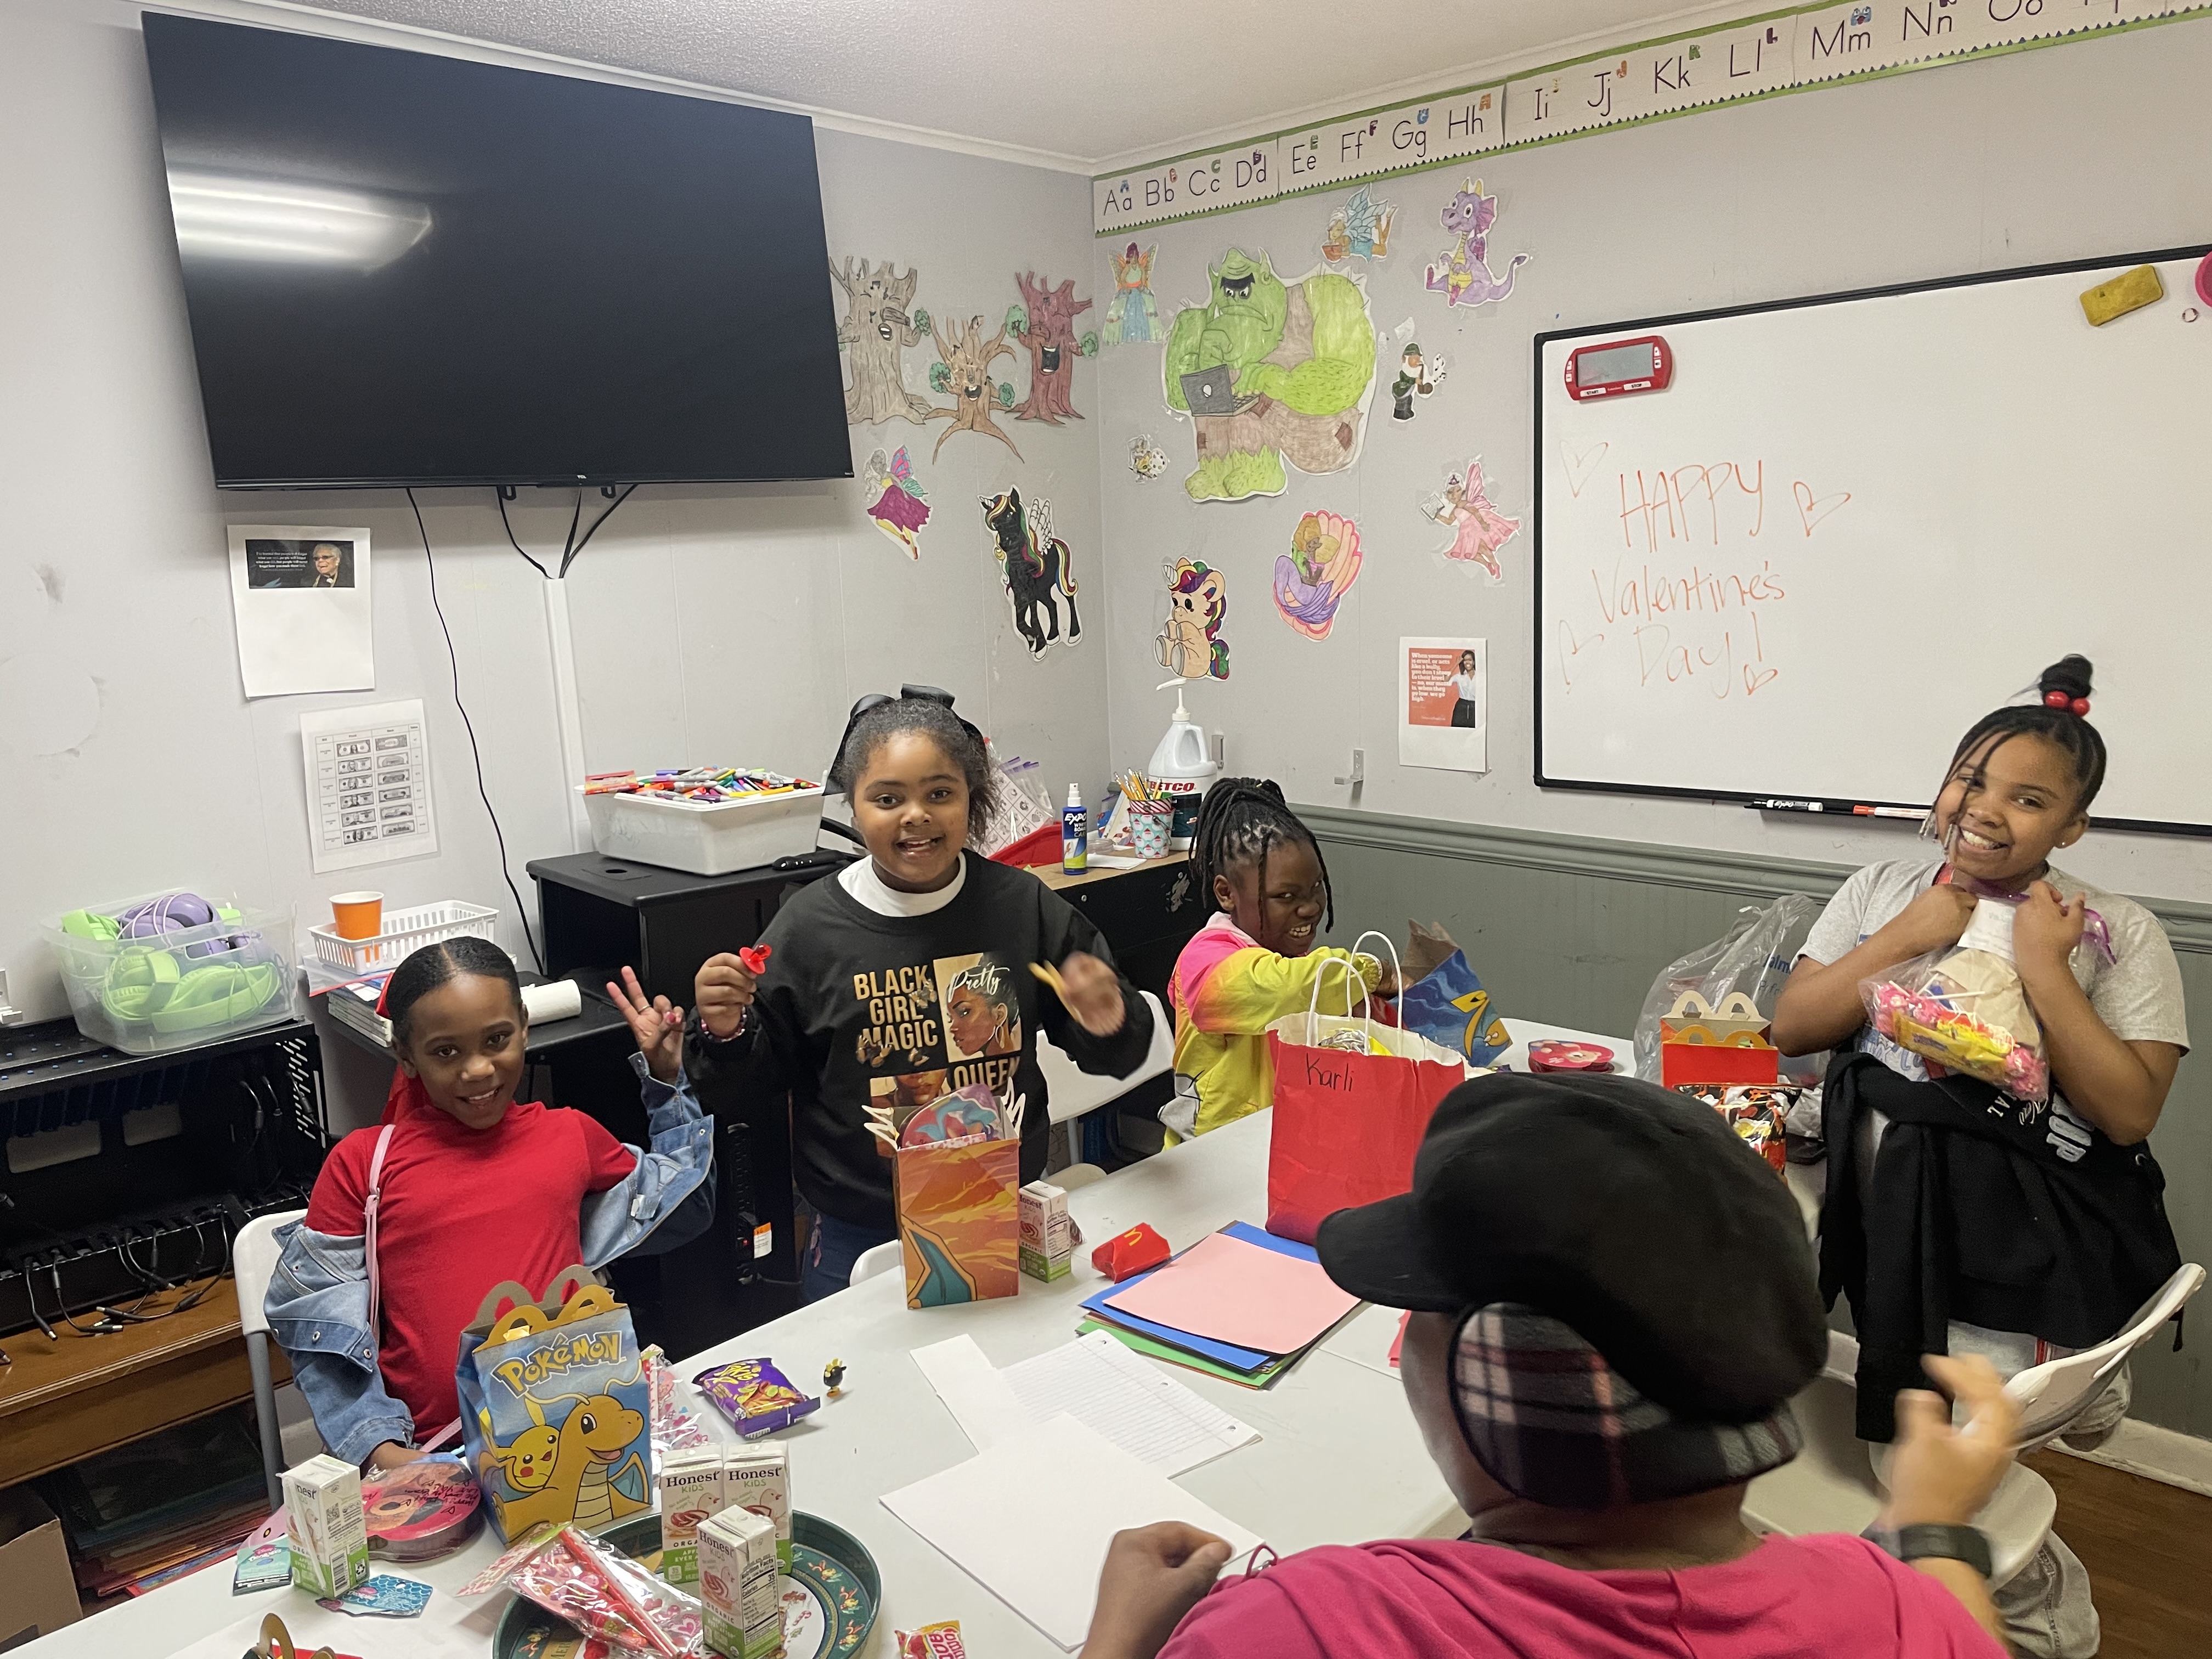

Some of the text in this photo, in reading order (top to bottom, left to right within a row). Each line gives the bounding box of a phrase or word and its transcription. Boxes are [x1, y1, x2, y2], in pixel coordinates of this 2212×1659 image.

[1103, 189, 1132, 216] Aa
[1146, 178, 1175, 207] Bb
[1188, 170, 1220, 196] Cc
[1237, 154, 1266, 188] Dd
[1292, 145, 1316, 174] Ee
[1341, 130, 1364, 163] Ff
[1392, 121, 1426, 157] Gg
[1448, 105, 1483, 139] Hh
[1534, 88, 1548, 120] Ii
[1588, 71, 1611, 117] Jj
[1655, 55, 1690, 94] Kk
[1730, 39, 1761, 77] Ll
[1812, 20, 1871, 60] Mm
[1903, 2, 1953, 41] Nn
[1620, 460, 1762, 552] HAPPY
[1592, 555, 1784, 623] Valentine's
[1633, 611, 1762, 699] Day!
[1064, 813, 1086, 825] EXPO
[854, 964, 930, 1000] BLACK
[947, 962, 1009, 1002] Pretty
[870, 996, 924, 1025] GIRL
[862, 1020, 938, 1051] MAGIC
[1306, 1052, 1354, 1092] Karli
[667, 1471, 720, 1487] Honest
[729, 1467, 783, 1481] Honest
[674, 1539, 697, 1547] ORGA
[699, 1529, 735, 1559] Honest
